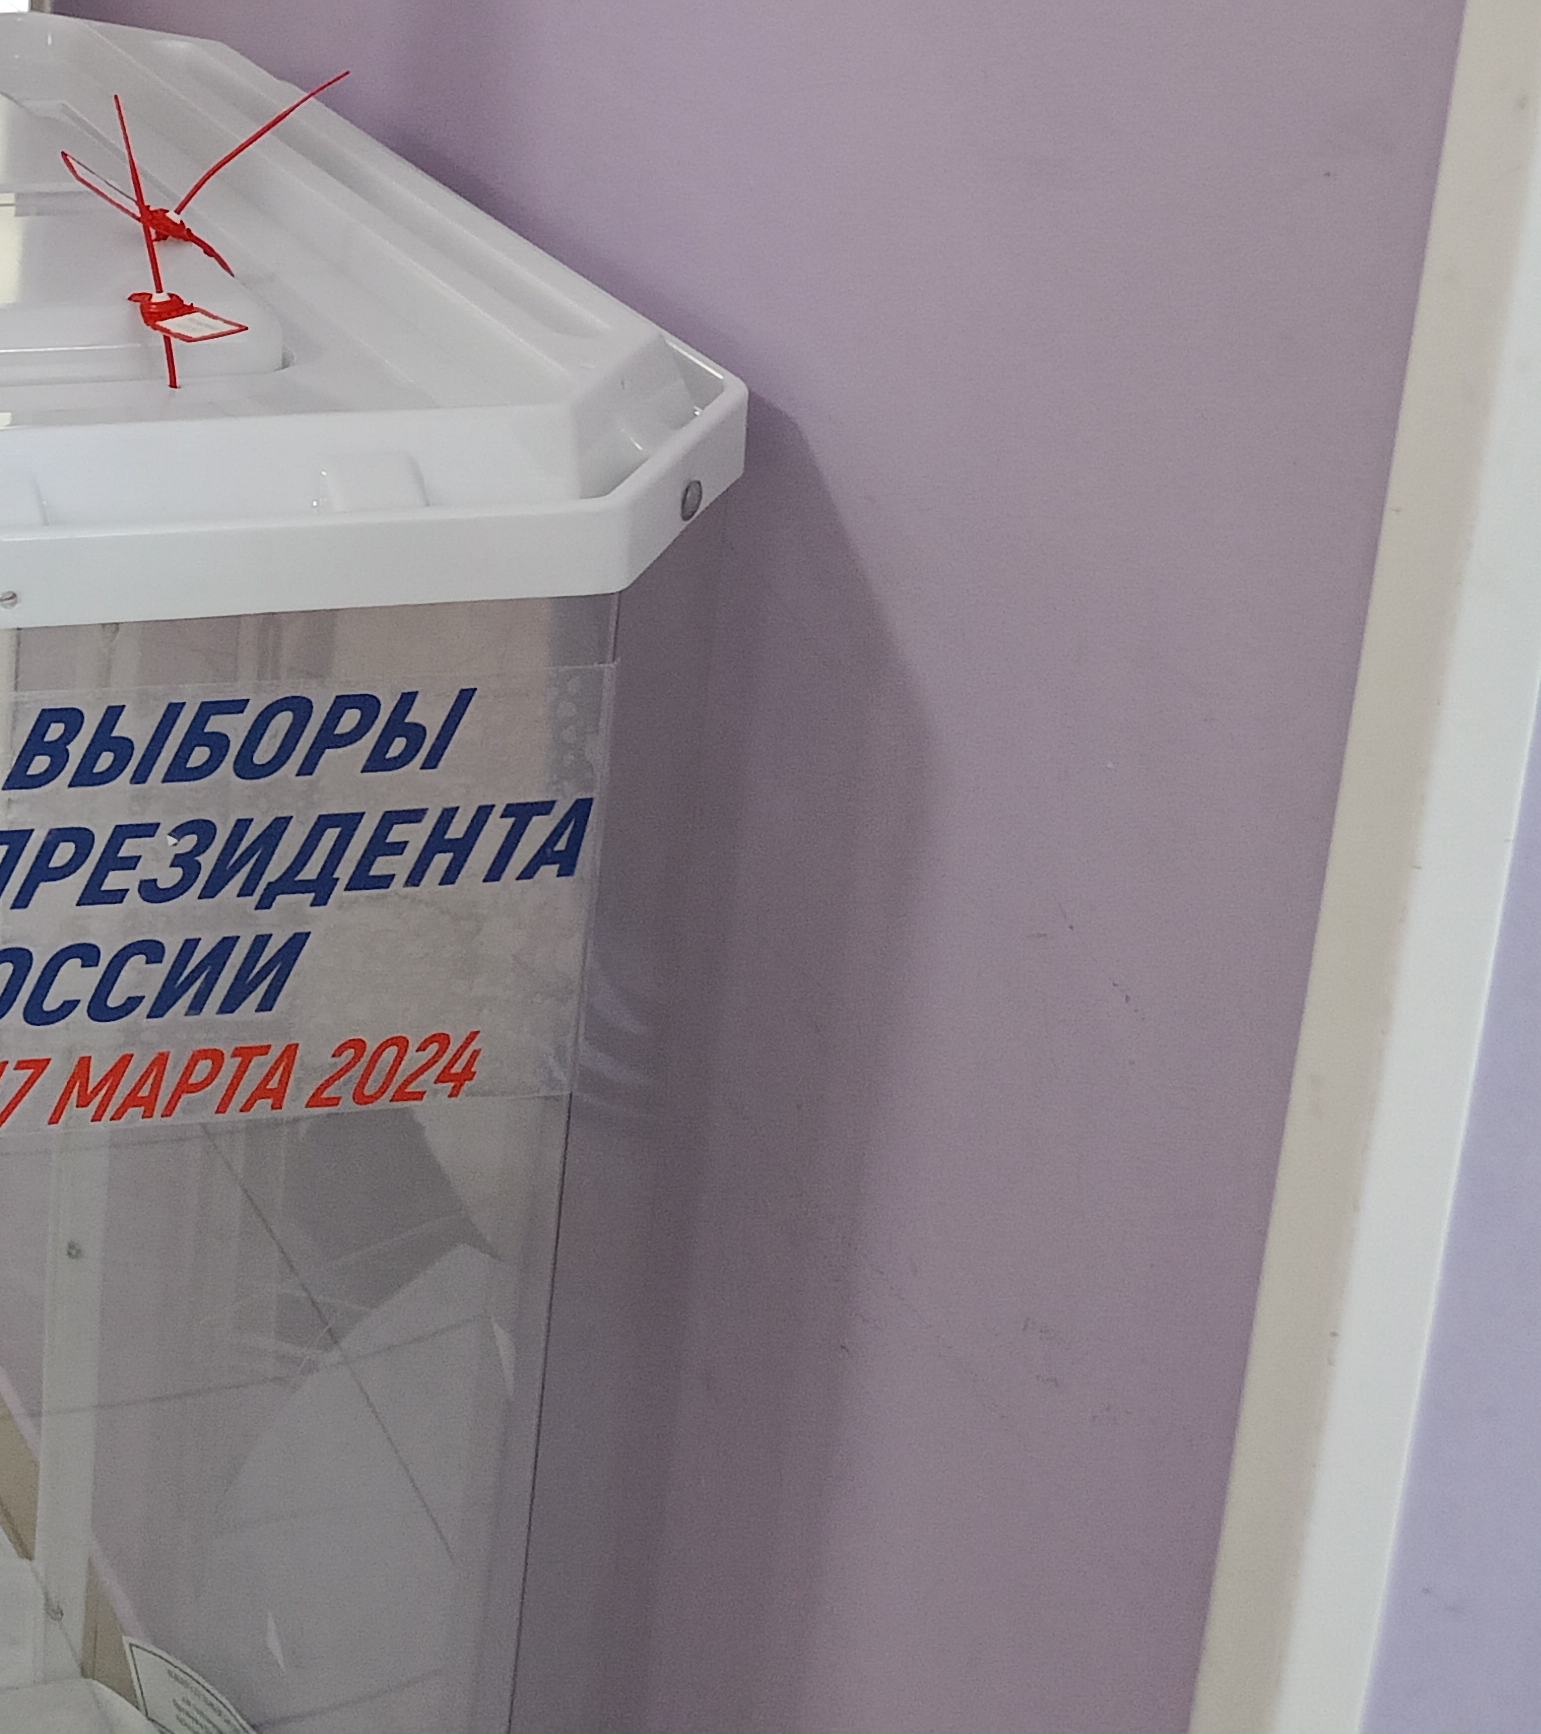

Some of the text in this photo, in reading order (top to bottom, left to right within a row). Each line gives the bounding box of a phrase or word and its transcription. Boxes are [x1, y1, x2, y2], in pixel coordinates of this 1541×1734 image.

[1, 687, 478, 792] ВЫБОРЫ
[47, 1042, 305, 1126] МАРТА
[305, 1029, 482, 1110] 2024
